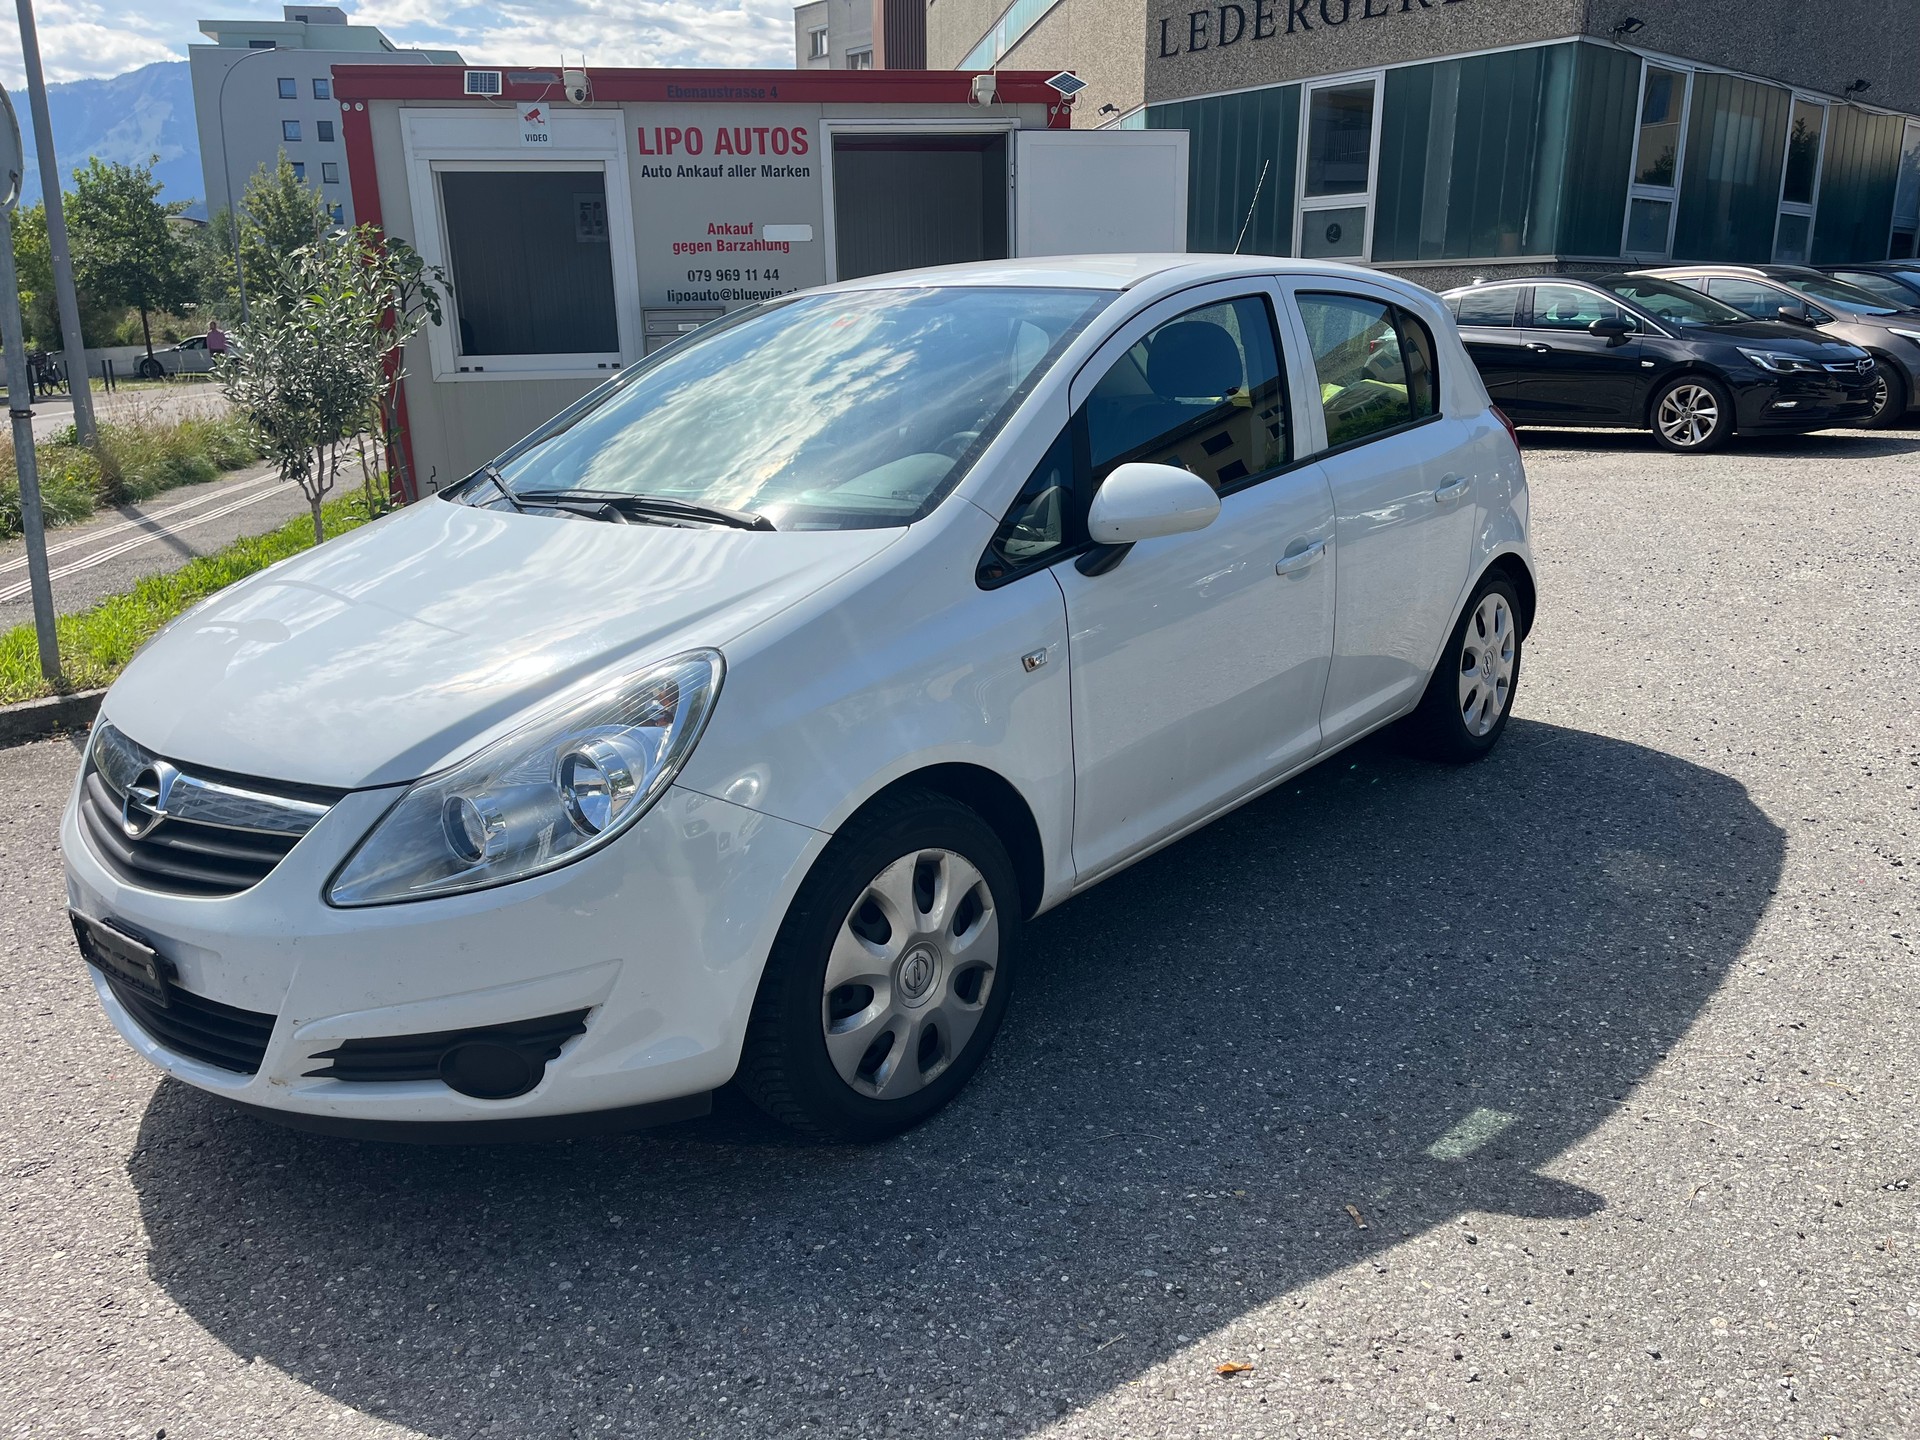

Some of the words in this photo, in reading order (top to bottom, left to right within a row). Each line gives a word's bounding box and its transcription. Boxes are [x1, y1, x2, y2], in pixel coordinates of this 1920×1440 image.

[667, 85, 766, 99] Ebenaustrasse
[770, 86, 778, 99] 4
[525, 134, 548, 142] VIDEO
[637, 127, 704, 156] LIPO
[714, 127, 809, 156] AUTOS
[641, 164, 673, 178] Auto
[676, 164, 724, 178] Ankauf
[727, 164, 757, 178] aller
[761, 164, 810, 178] Marken
[707, 222, 754, 235] Ankauf
[672, 241, 712, 255] gegen
[716, 239, 790, 254] Barzahlung
[687, 269, 712, 282] 079
[716, 269, 741, 282] 969
[745, 269, 758, 281] 11
[763, 268, 780, 281] 44
